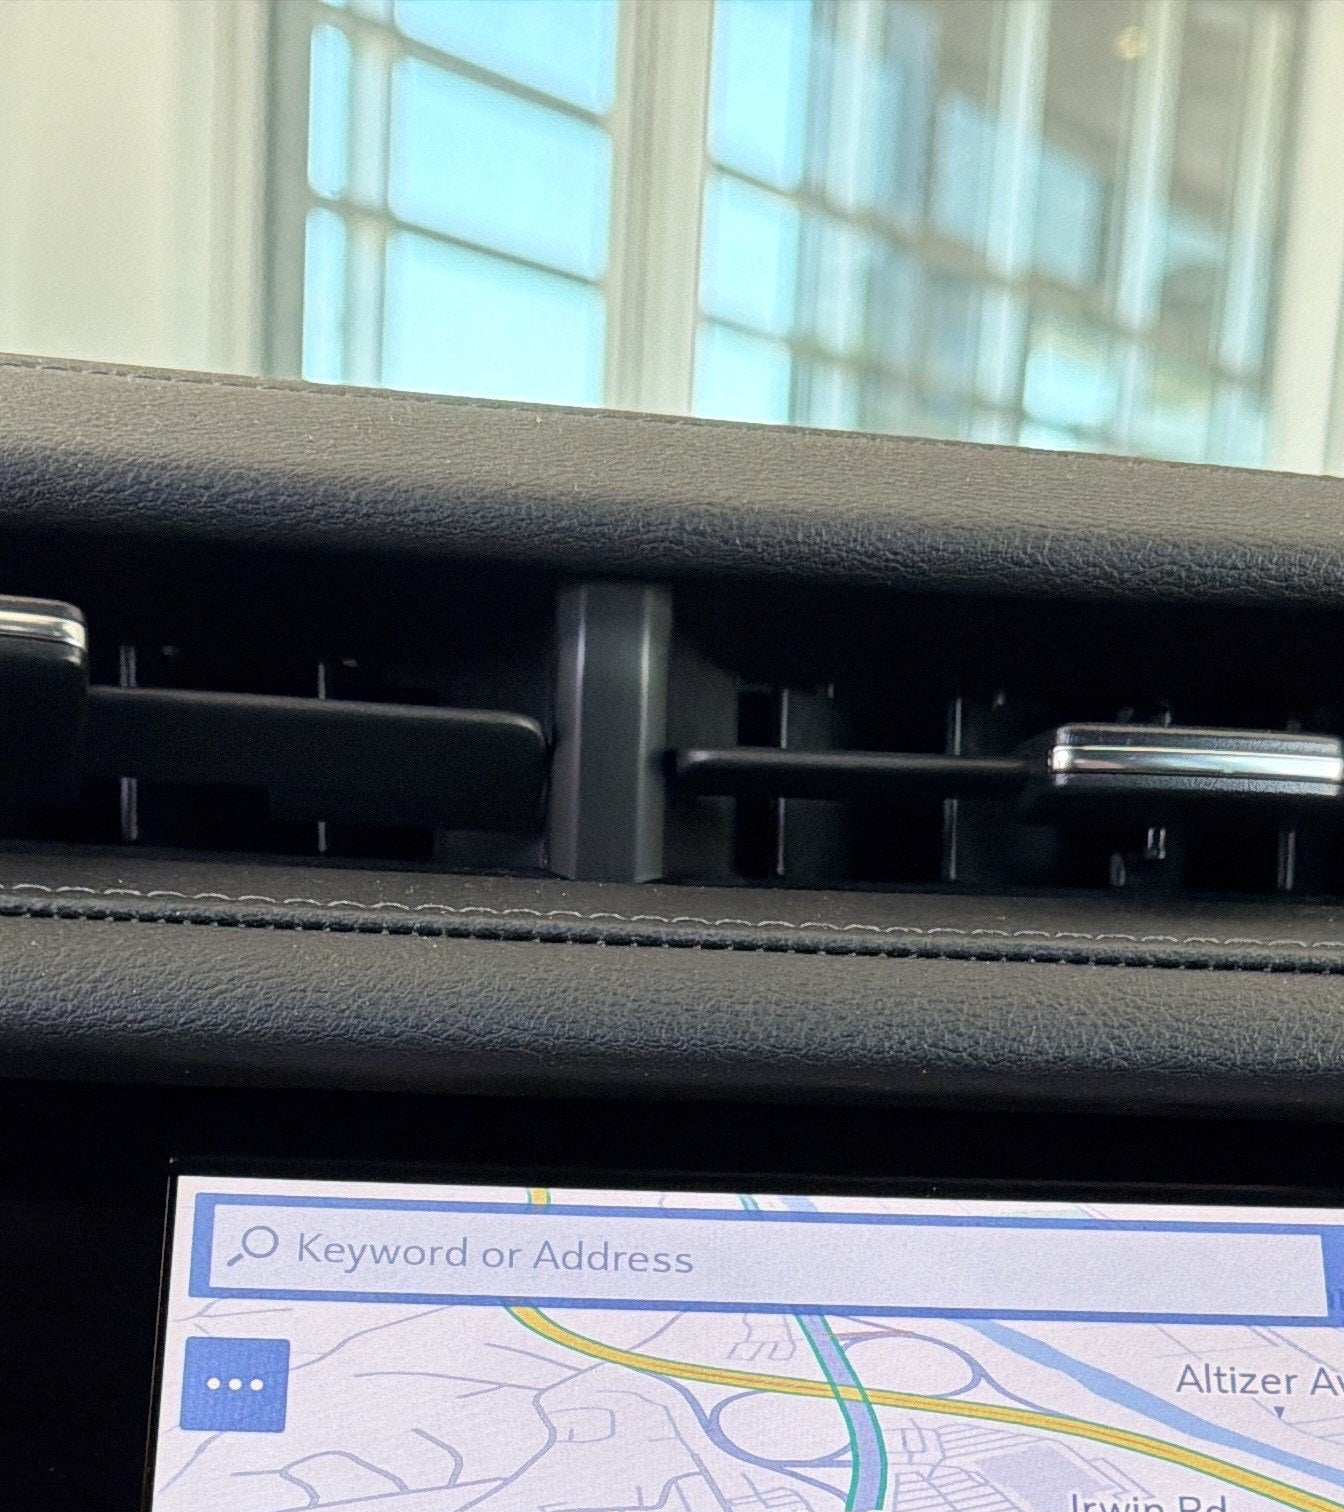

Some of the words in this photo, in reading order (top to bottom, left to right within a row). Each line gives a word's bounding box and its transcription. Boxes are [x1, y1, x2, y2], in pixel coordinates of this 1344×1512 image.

[297, 1232, 468, 1274] Keyword
[481, 1245, 523, 1269] or
[532, 1240, 694, 1274] Address
[1175, 1362, 1298, 1395] Altizer
